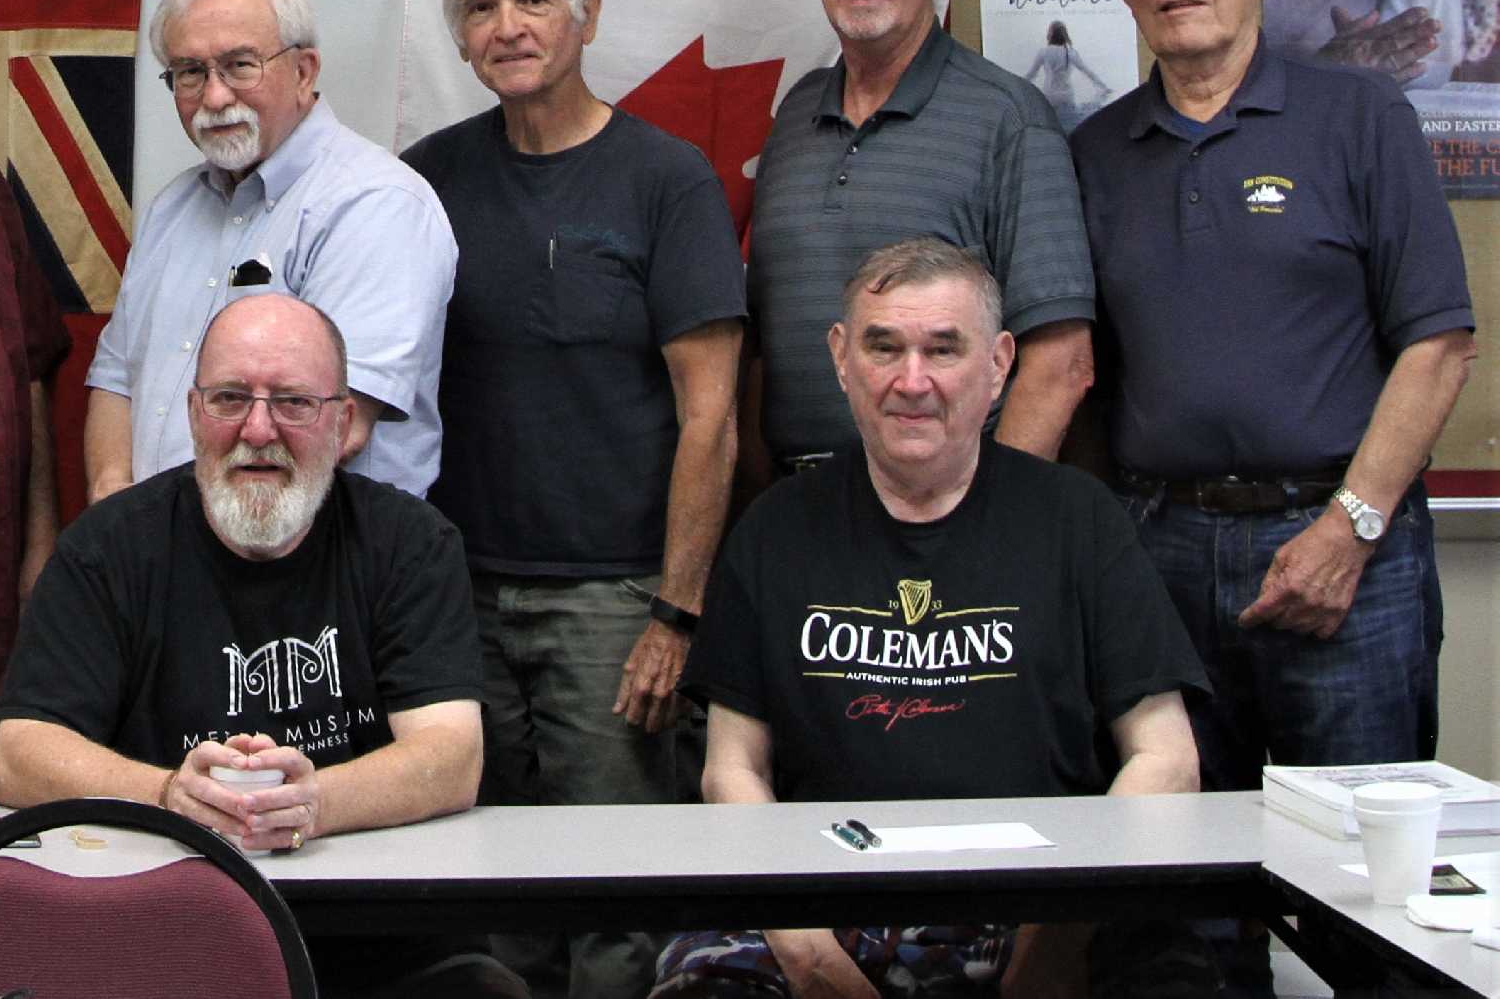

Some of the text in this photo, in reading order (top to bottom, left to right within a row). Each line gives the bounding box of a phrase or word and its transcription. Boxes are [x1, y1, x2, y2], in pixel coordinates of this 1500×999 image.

[1422, 121, 1451, 132] AND
[1434, 159, 1476, 176] THE
[801, 612, 1013, 670] COLEMAN'S
[846, 671, 967, 686] AUTHENTIC IRISH PUB
